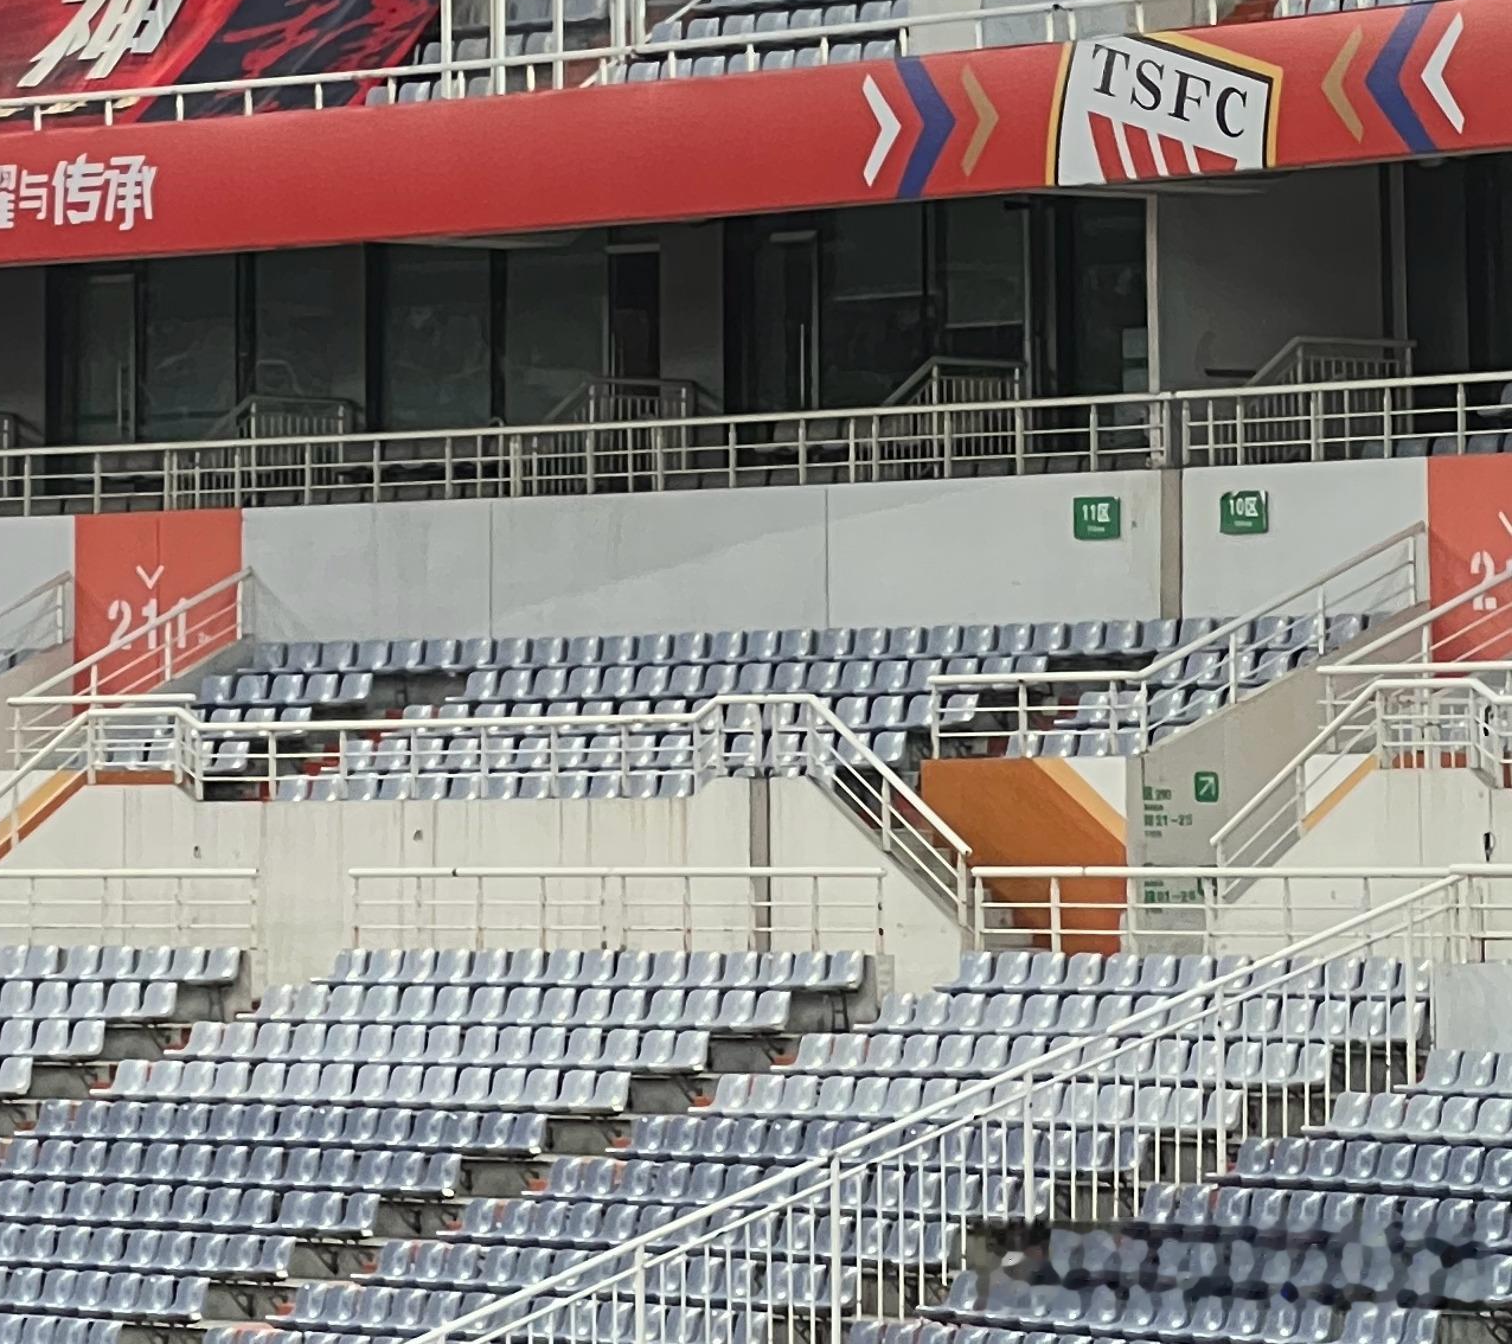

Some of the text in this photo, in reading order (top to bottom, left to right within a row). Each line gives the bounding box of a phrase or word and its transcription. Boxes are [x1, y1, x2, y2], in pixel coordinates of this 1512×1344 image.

[1091, 43, 1249, 139] TSFC
[1082, 503, 1111, 522] 11区
[107, 597, 188, 650] 211
